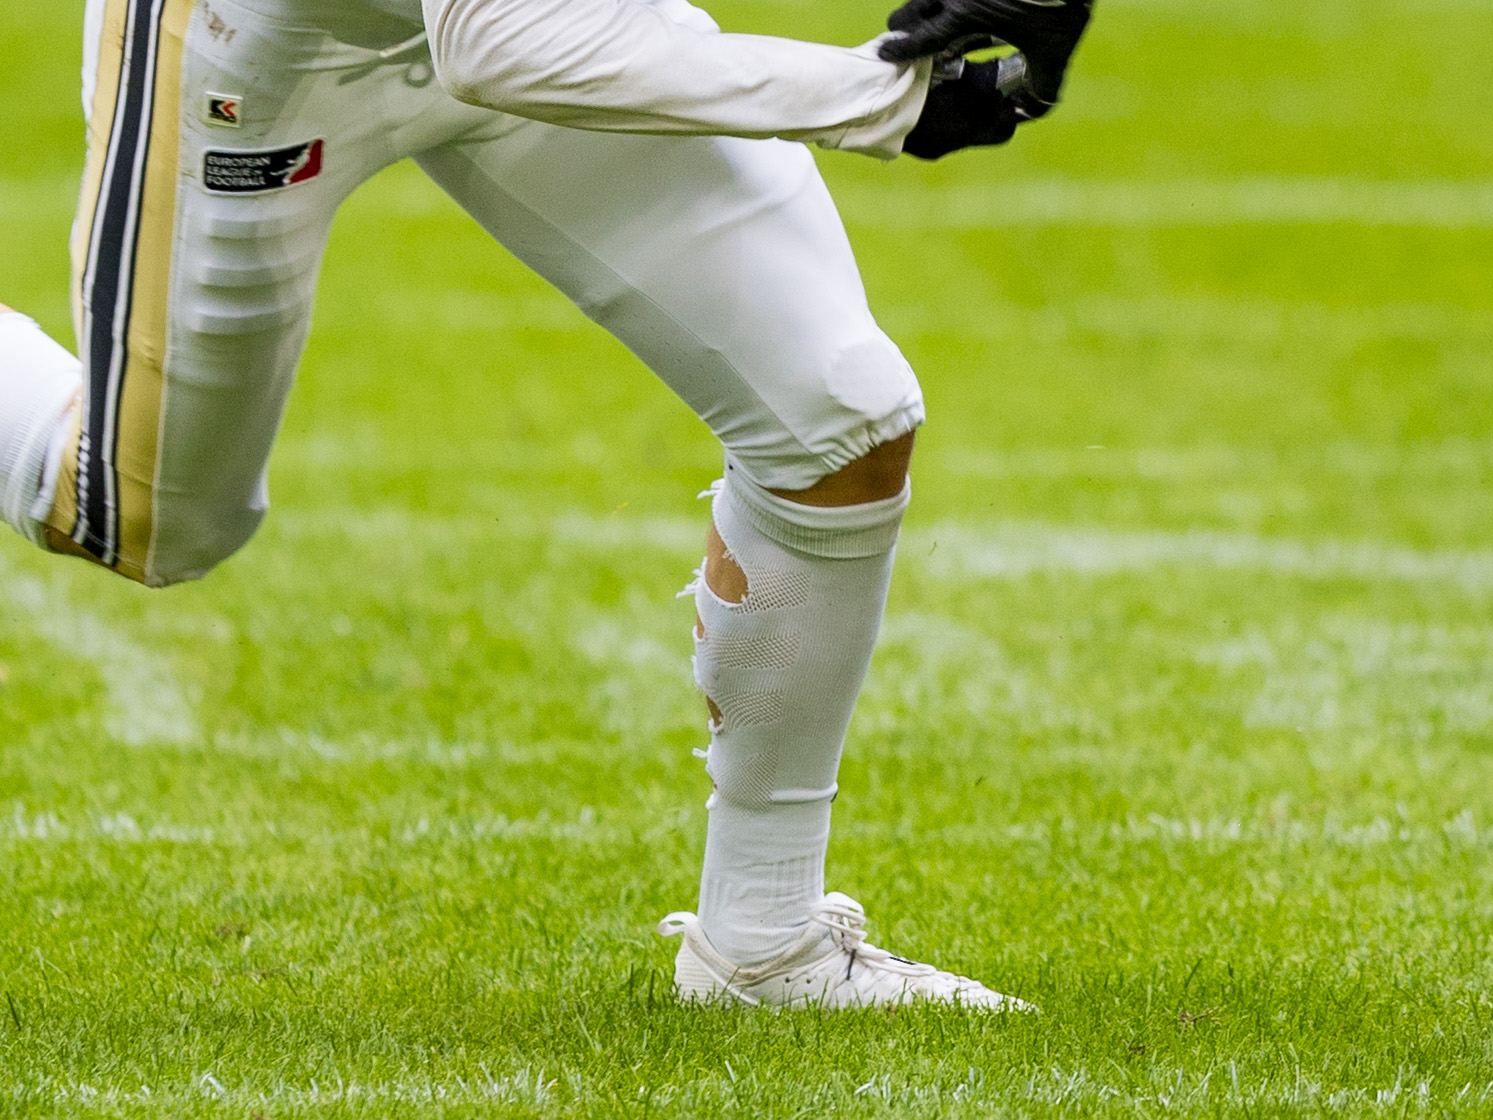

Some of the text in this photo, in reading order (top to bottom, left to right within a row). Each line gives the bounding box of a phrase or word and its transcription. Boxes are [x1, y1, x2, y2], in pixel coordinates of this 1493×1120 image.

[207, 156, 271, 166] EUROPEAN
[206, 166, 252, 177] LEAGUE
[206, 176, 266, 186] FOOTBALL
